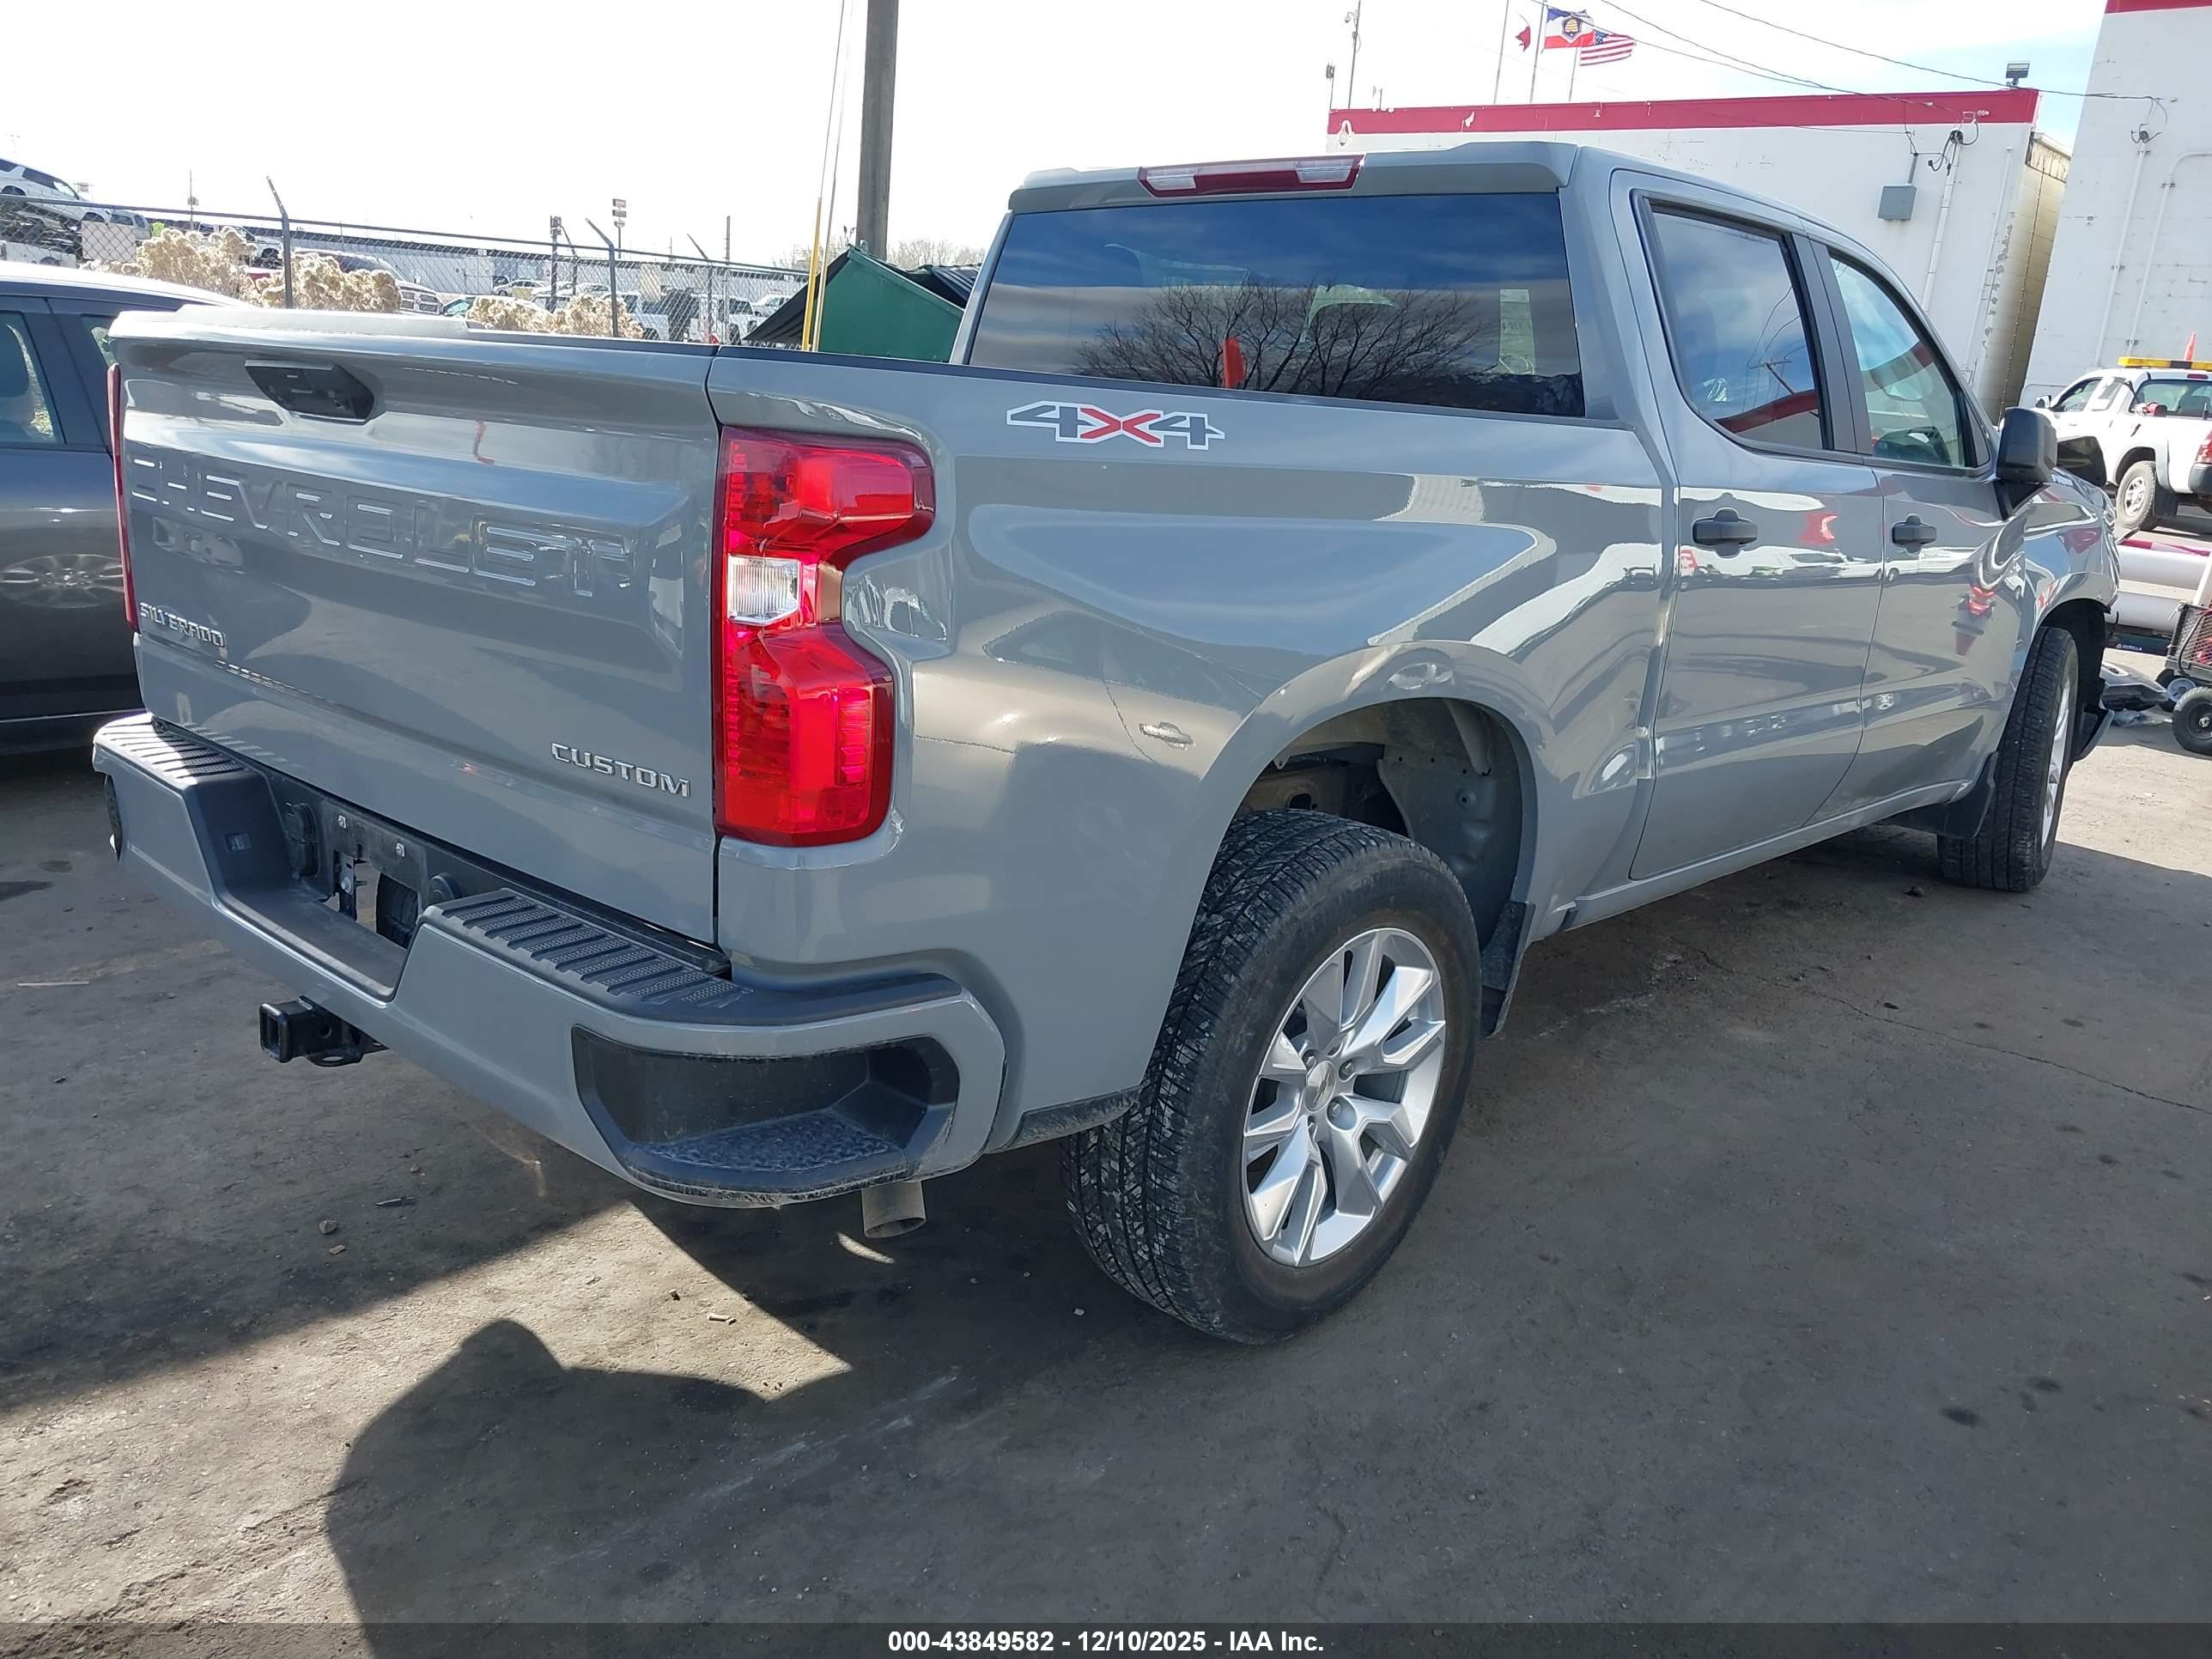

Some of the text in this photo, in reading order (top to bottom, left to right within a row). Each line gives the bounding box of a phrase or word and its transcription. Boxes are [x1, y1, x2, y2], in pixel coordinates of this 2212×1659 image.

[131, 455, 634, 599] CHEVROLET
[139, 602, 226, 647] SILVERADO
[551, 742, 690, 798] CUSTOM
